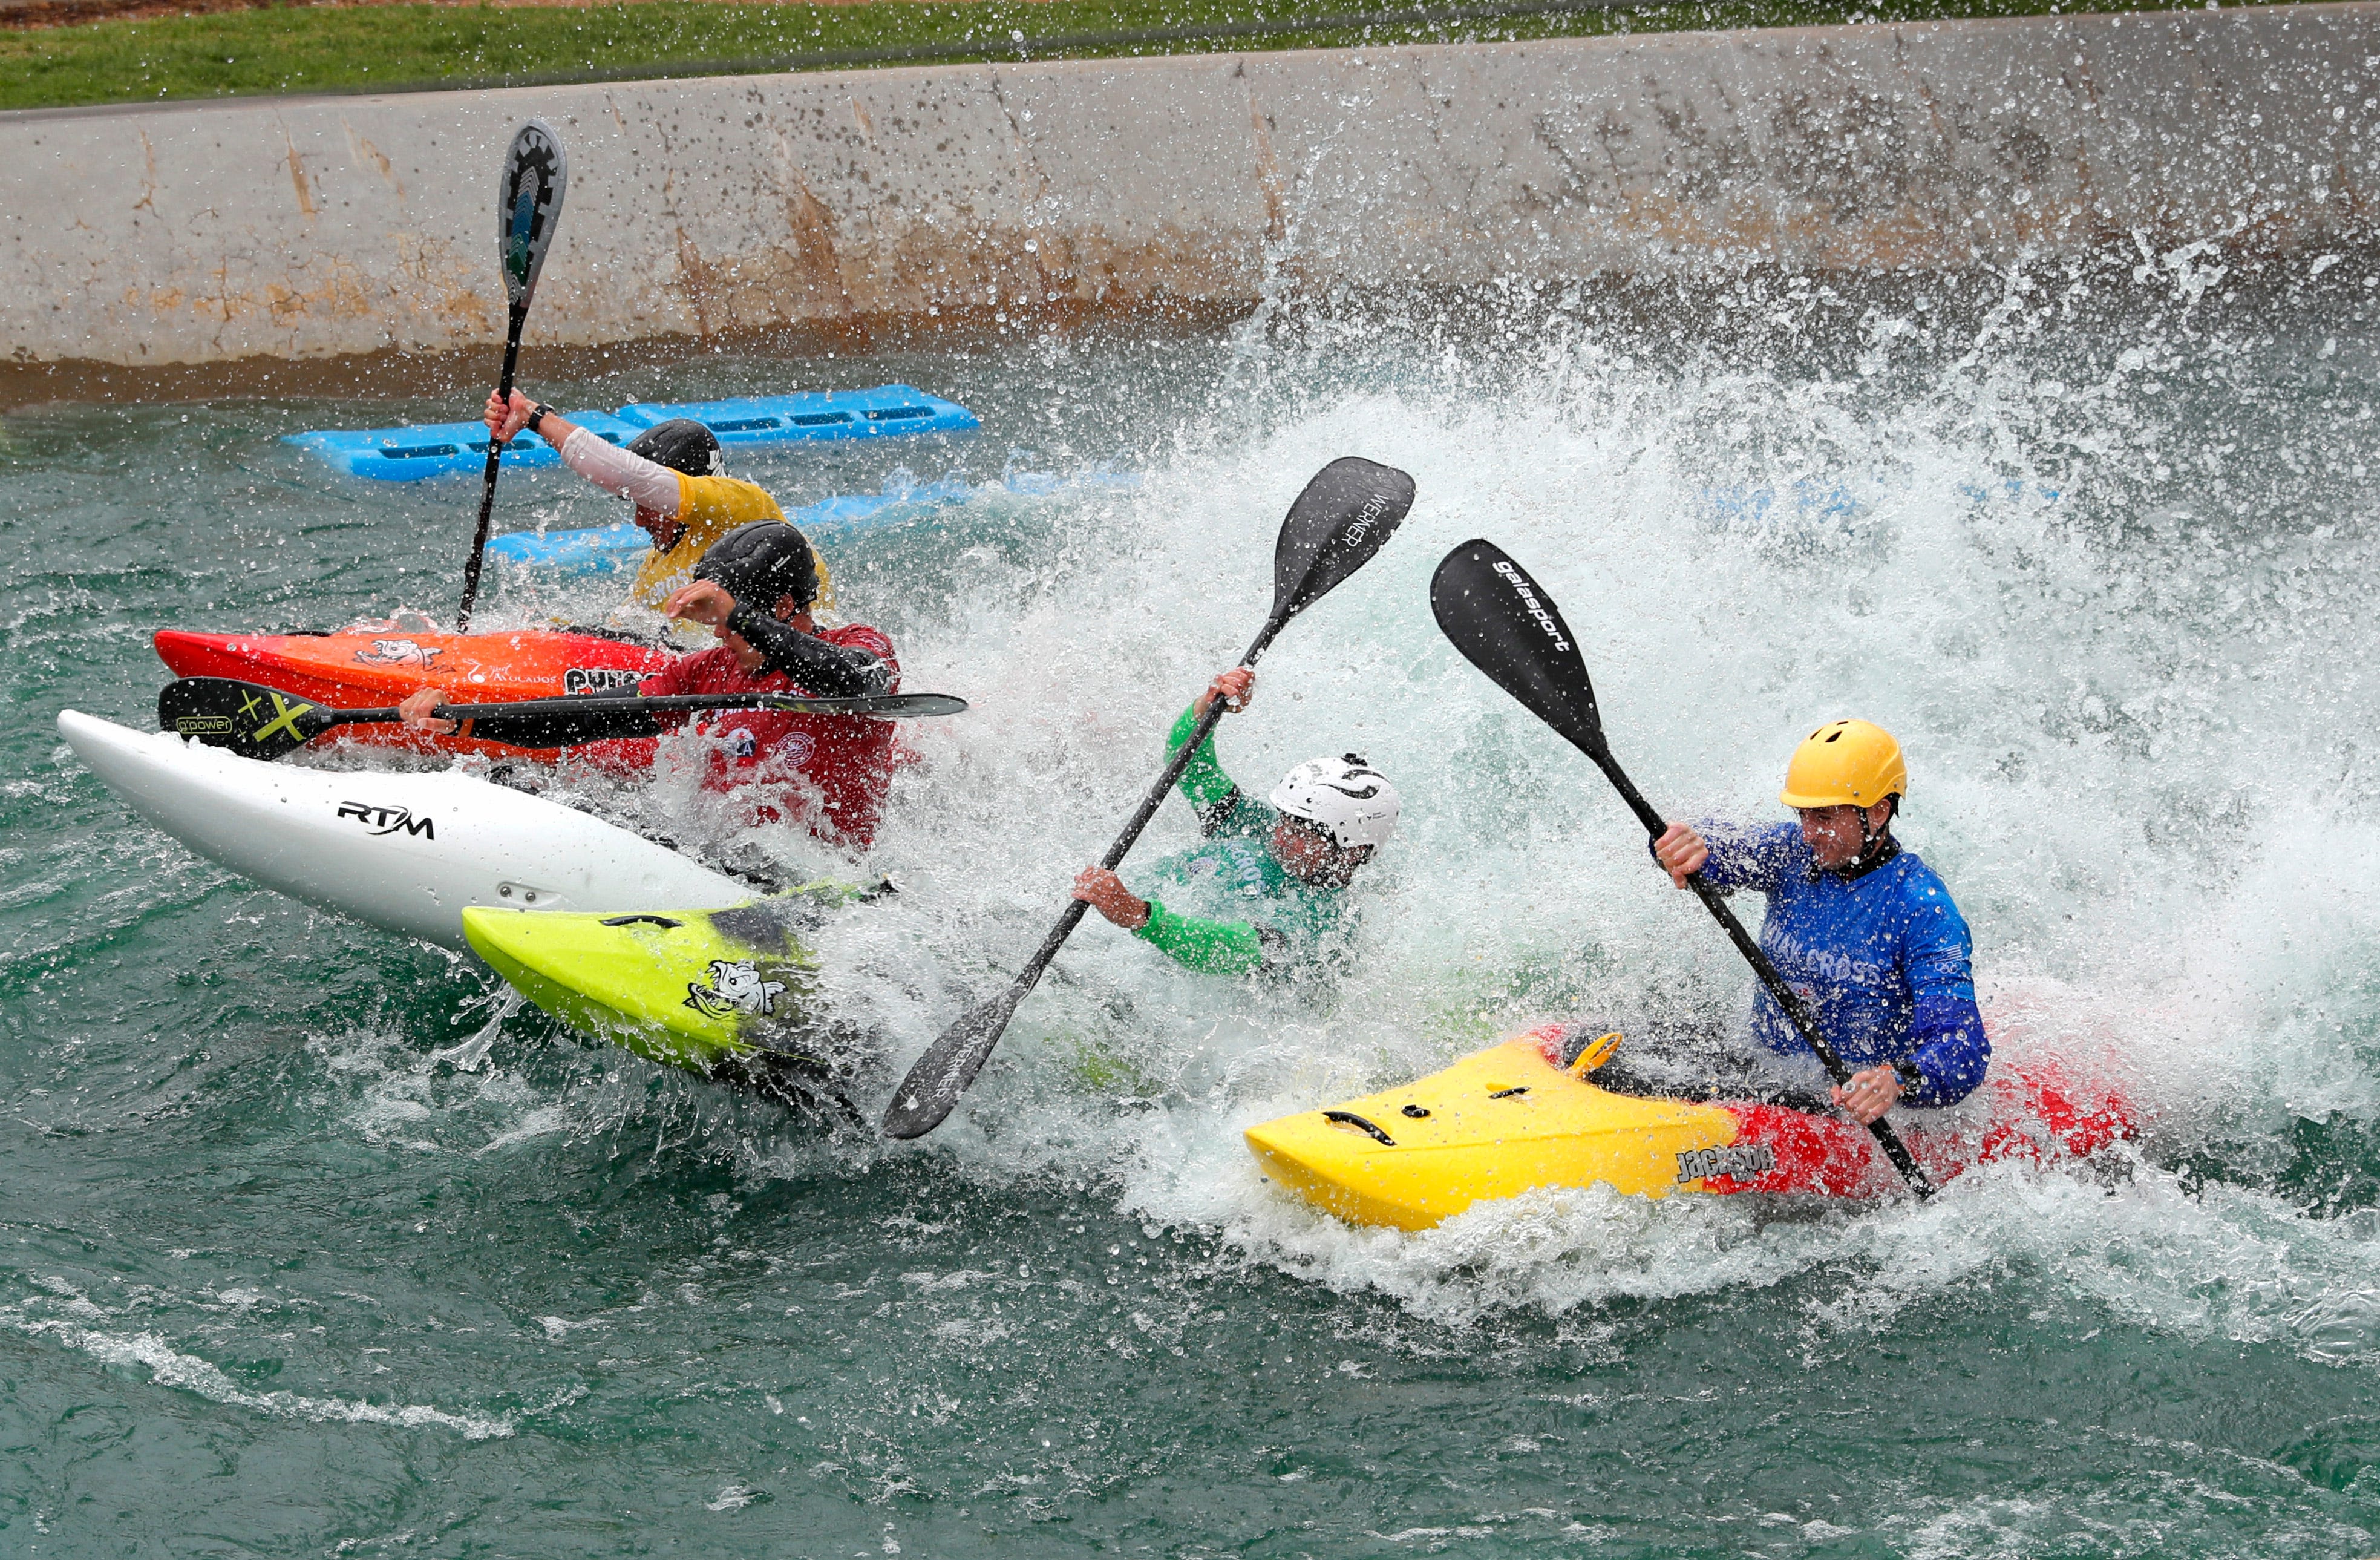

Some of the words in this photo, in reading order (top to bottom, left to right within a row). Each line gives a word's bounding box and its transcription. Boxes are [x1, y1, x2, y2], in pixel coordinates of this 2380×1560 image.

[1341, 494, 1390, 547] WERNER
[1492, 560, 1571, 652] galasport
[178, 719, 229, 733] g'power
[338, 801, 434, 841] RTM
[1806, 949, 1881, 985] CROSS
